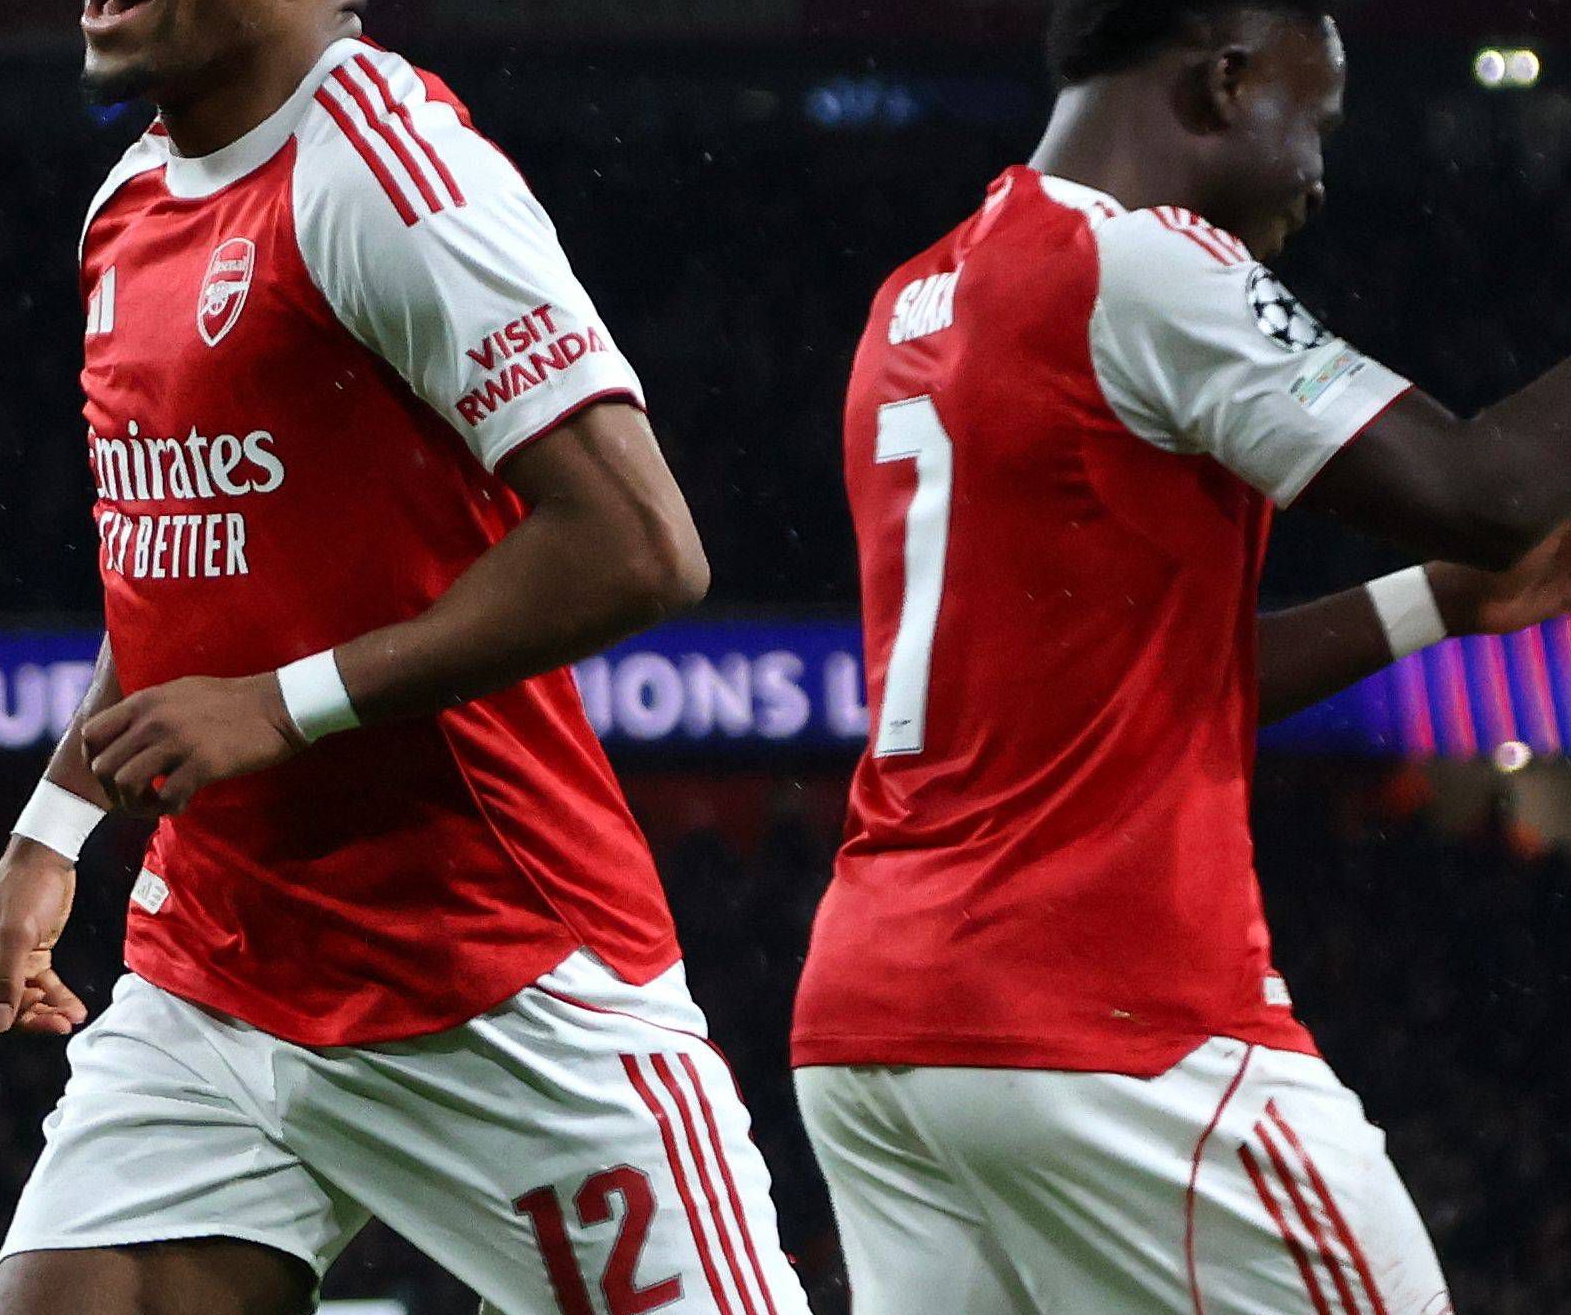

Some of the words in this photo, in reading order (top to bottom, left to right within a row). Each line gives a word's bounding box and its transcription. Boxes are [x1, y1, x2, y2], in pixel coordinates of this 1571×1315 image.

[455, 326, 609, 427] RWANDA
[465, 303, 557, 371] VISIT
[87, 419, 285, 501] mirates
[133, 512, 249, 578] BETTER
[874, 394, 953, 758] 7
